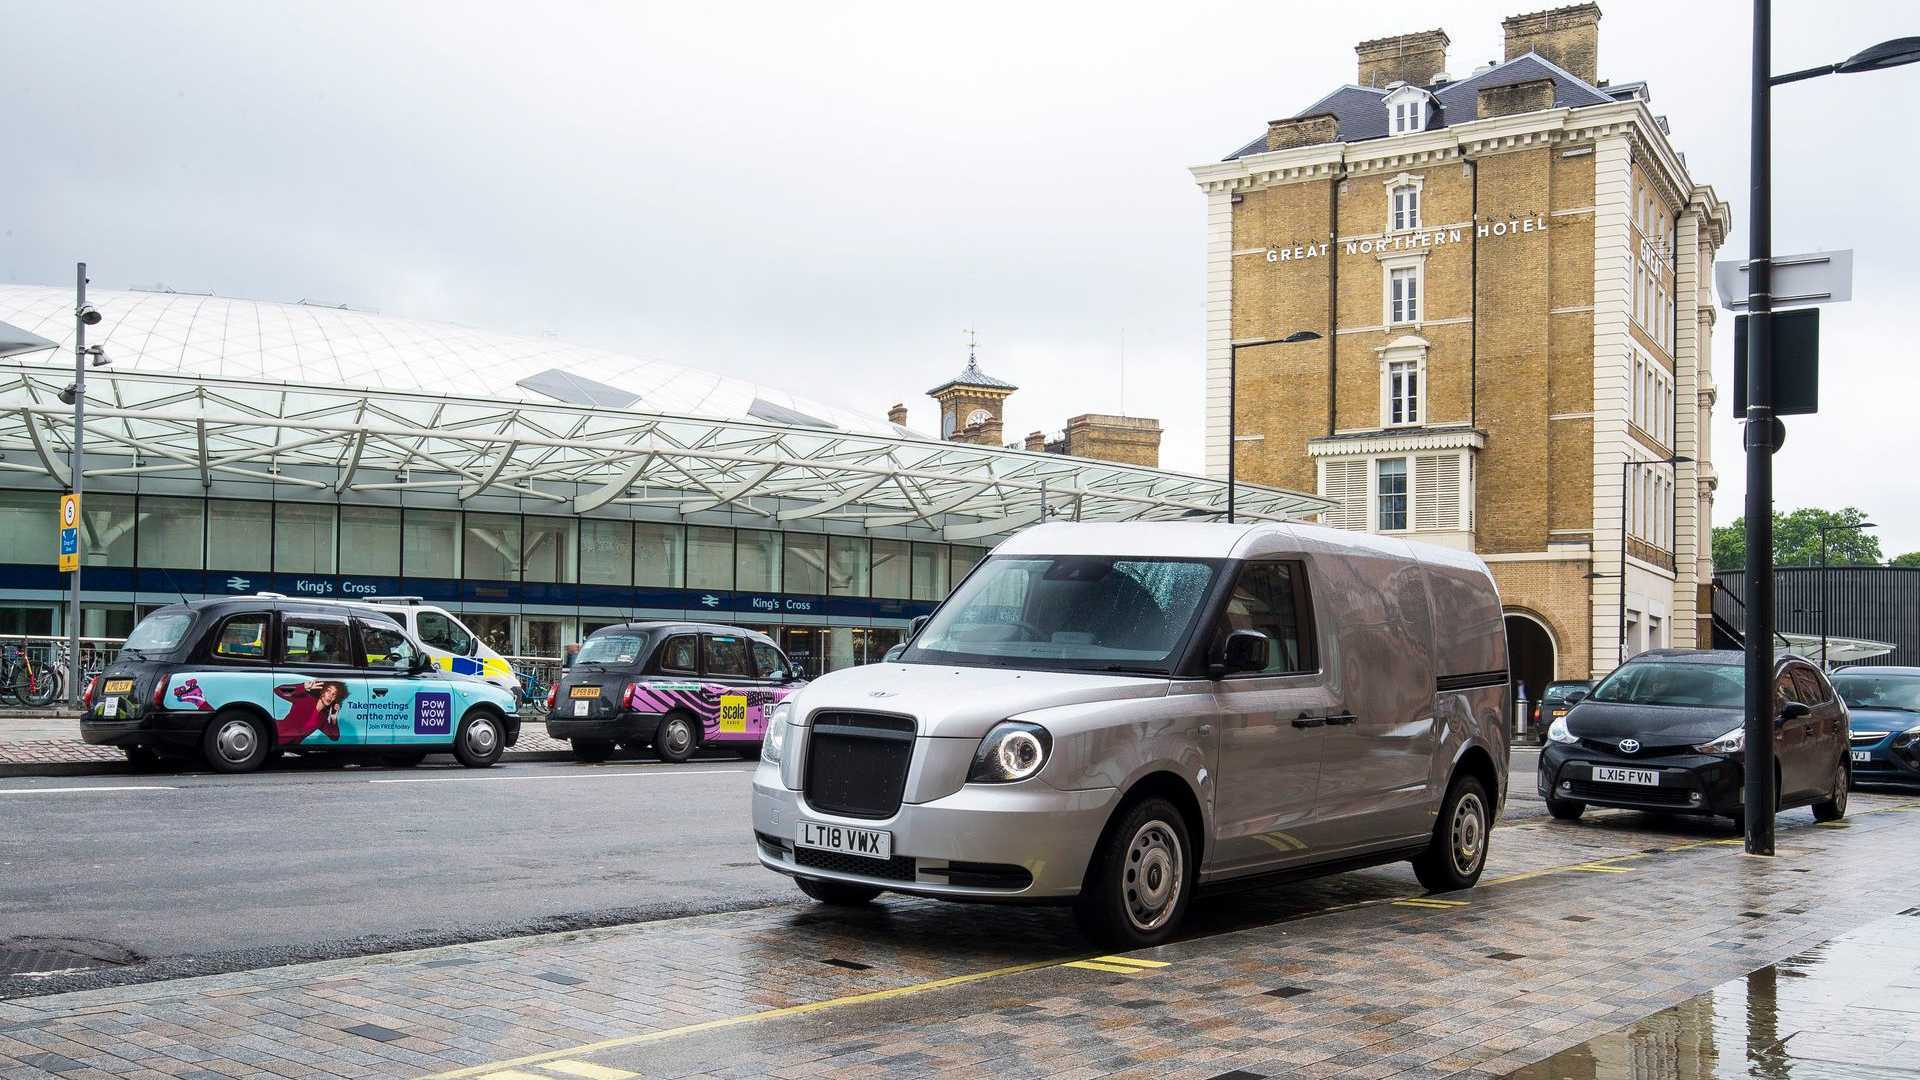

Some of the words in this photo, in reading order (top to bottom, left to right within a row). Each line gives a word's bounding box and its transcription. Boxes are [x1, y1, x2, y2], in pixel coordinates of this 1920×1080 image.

[1266, 244, 1329, 262] GREAT
[1346, 229, 1461, 255] NORTHERN
[1477, 218, 1547, 238] HOTEL
[296, 580, 333, 594] King's
[342, 581, 377, 594] Cross
[752, 597, 780, 610] King's
[786, 599, 811, 610] Cross
[348, 701, 368, 710] Take
[369, 701, 409, 711] meetings
[421, 700, 445, 709] POW
[369, 712, 383, 720] the
[421, 709, 445, 718] WOW
[722, 703, 745, 720] scala
[421, 718, 445, 727] NOW
[1599, 768, 1626, 781] LX15
[1628, 771, 1652, 783] FVN
[805, 824, 842, 848] LT18
[847, 829, 880, 854] VWX
